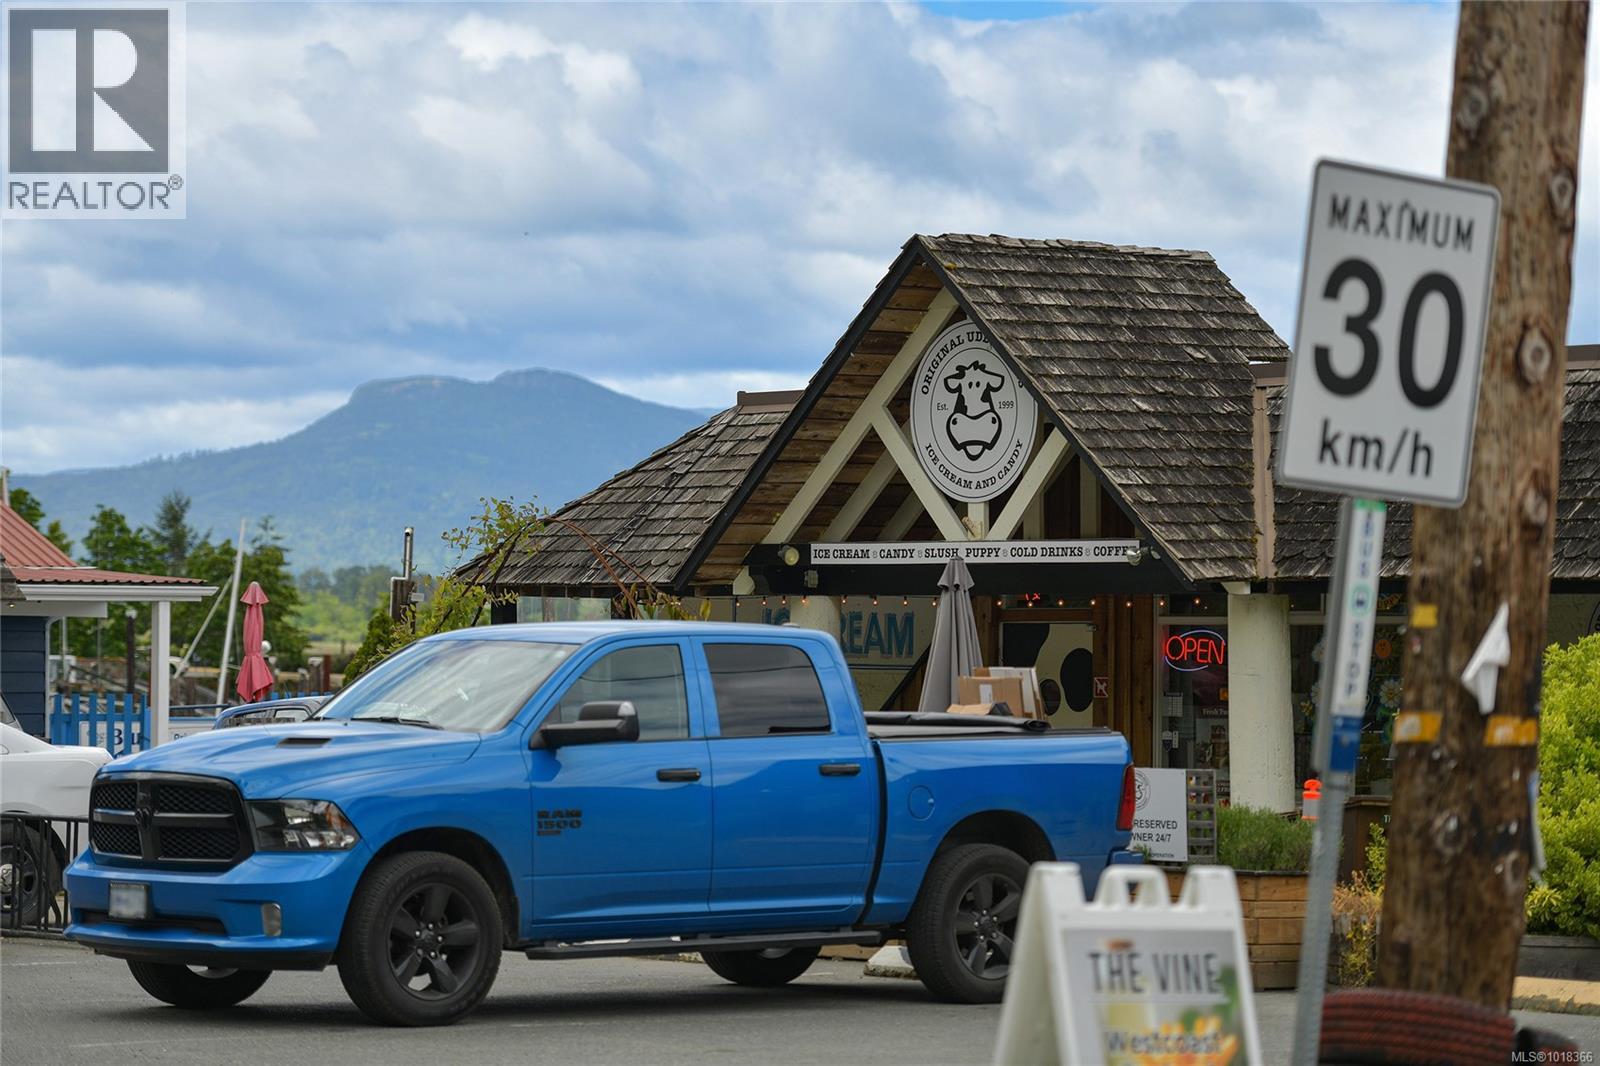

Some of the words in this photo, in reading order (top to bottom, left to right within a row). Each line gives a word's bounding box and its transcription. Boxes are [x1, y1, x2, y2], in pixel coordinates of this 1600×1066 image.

[1327, 193, 1475, 251] MAXIMUM
[1313, 257, 1465, 410] 30
[921, 334, 965, 395] ORIGINAL
[936, 402, 949, 411] Est.
[998, 401, 1014, 409] 1999
[925, 443, 940, 464] ICE
[938, 462, 973, 489] CREAM
[974, 477, 997, 490] AND
[997, 438, 1024, 479] CANDY
[1318, 418, 1433, 478] km/h
[813, 548, 830, 559] ICE
[832, 548, 870, 559] CREAM
[879, 548, 915, 559] CANDY
[924, 547, 959, 558] SLUSH
[965, 547, 1001, 558] PUPPY
[1010, 546, 1038, 557] COLD
[1040, 546, 1083, 557] DRINKS
[1165, 635, 1226, 665] OPEN
[537, 819, 582, 829] 1500
[1131, 832, 1153, 842] WNER
[1155, 833, 1171, 843] 24/7
[1134, 819, 1178, 830] RESERVED
[1088, 952, 1144, 994] THE
[1151, 952, 1221, 994] VINE
